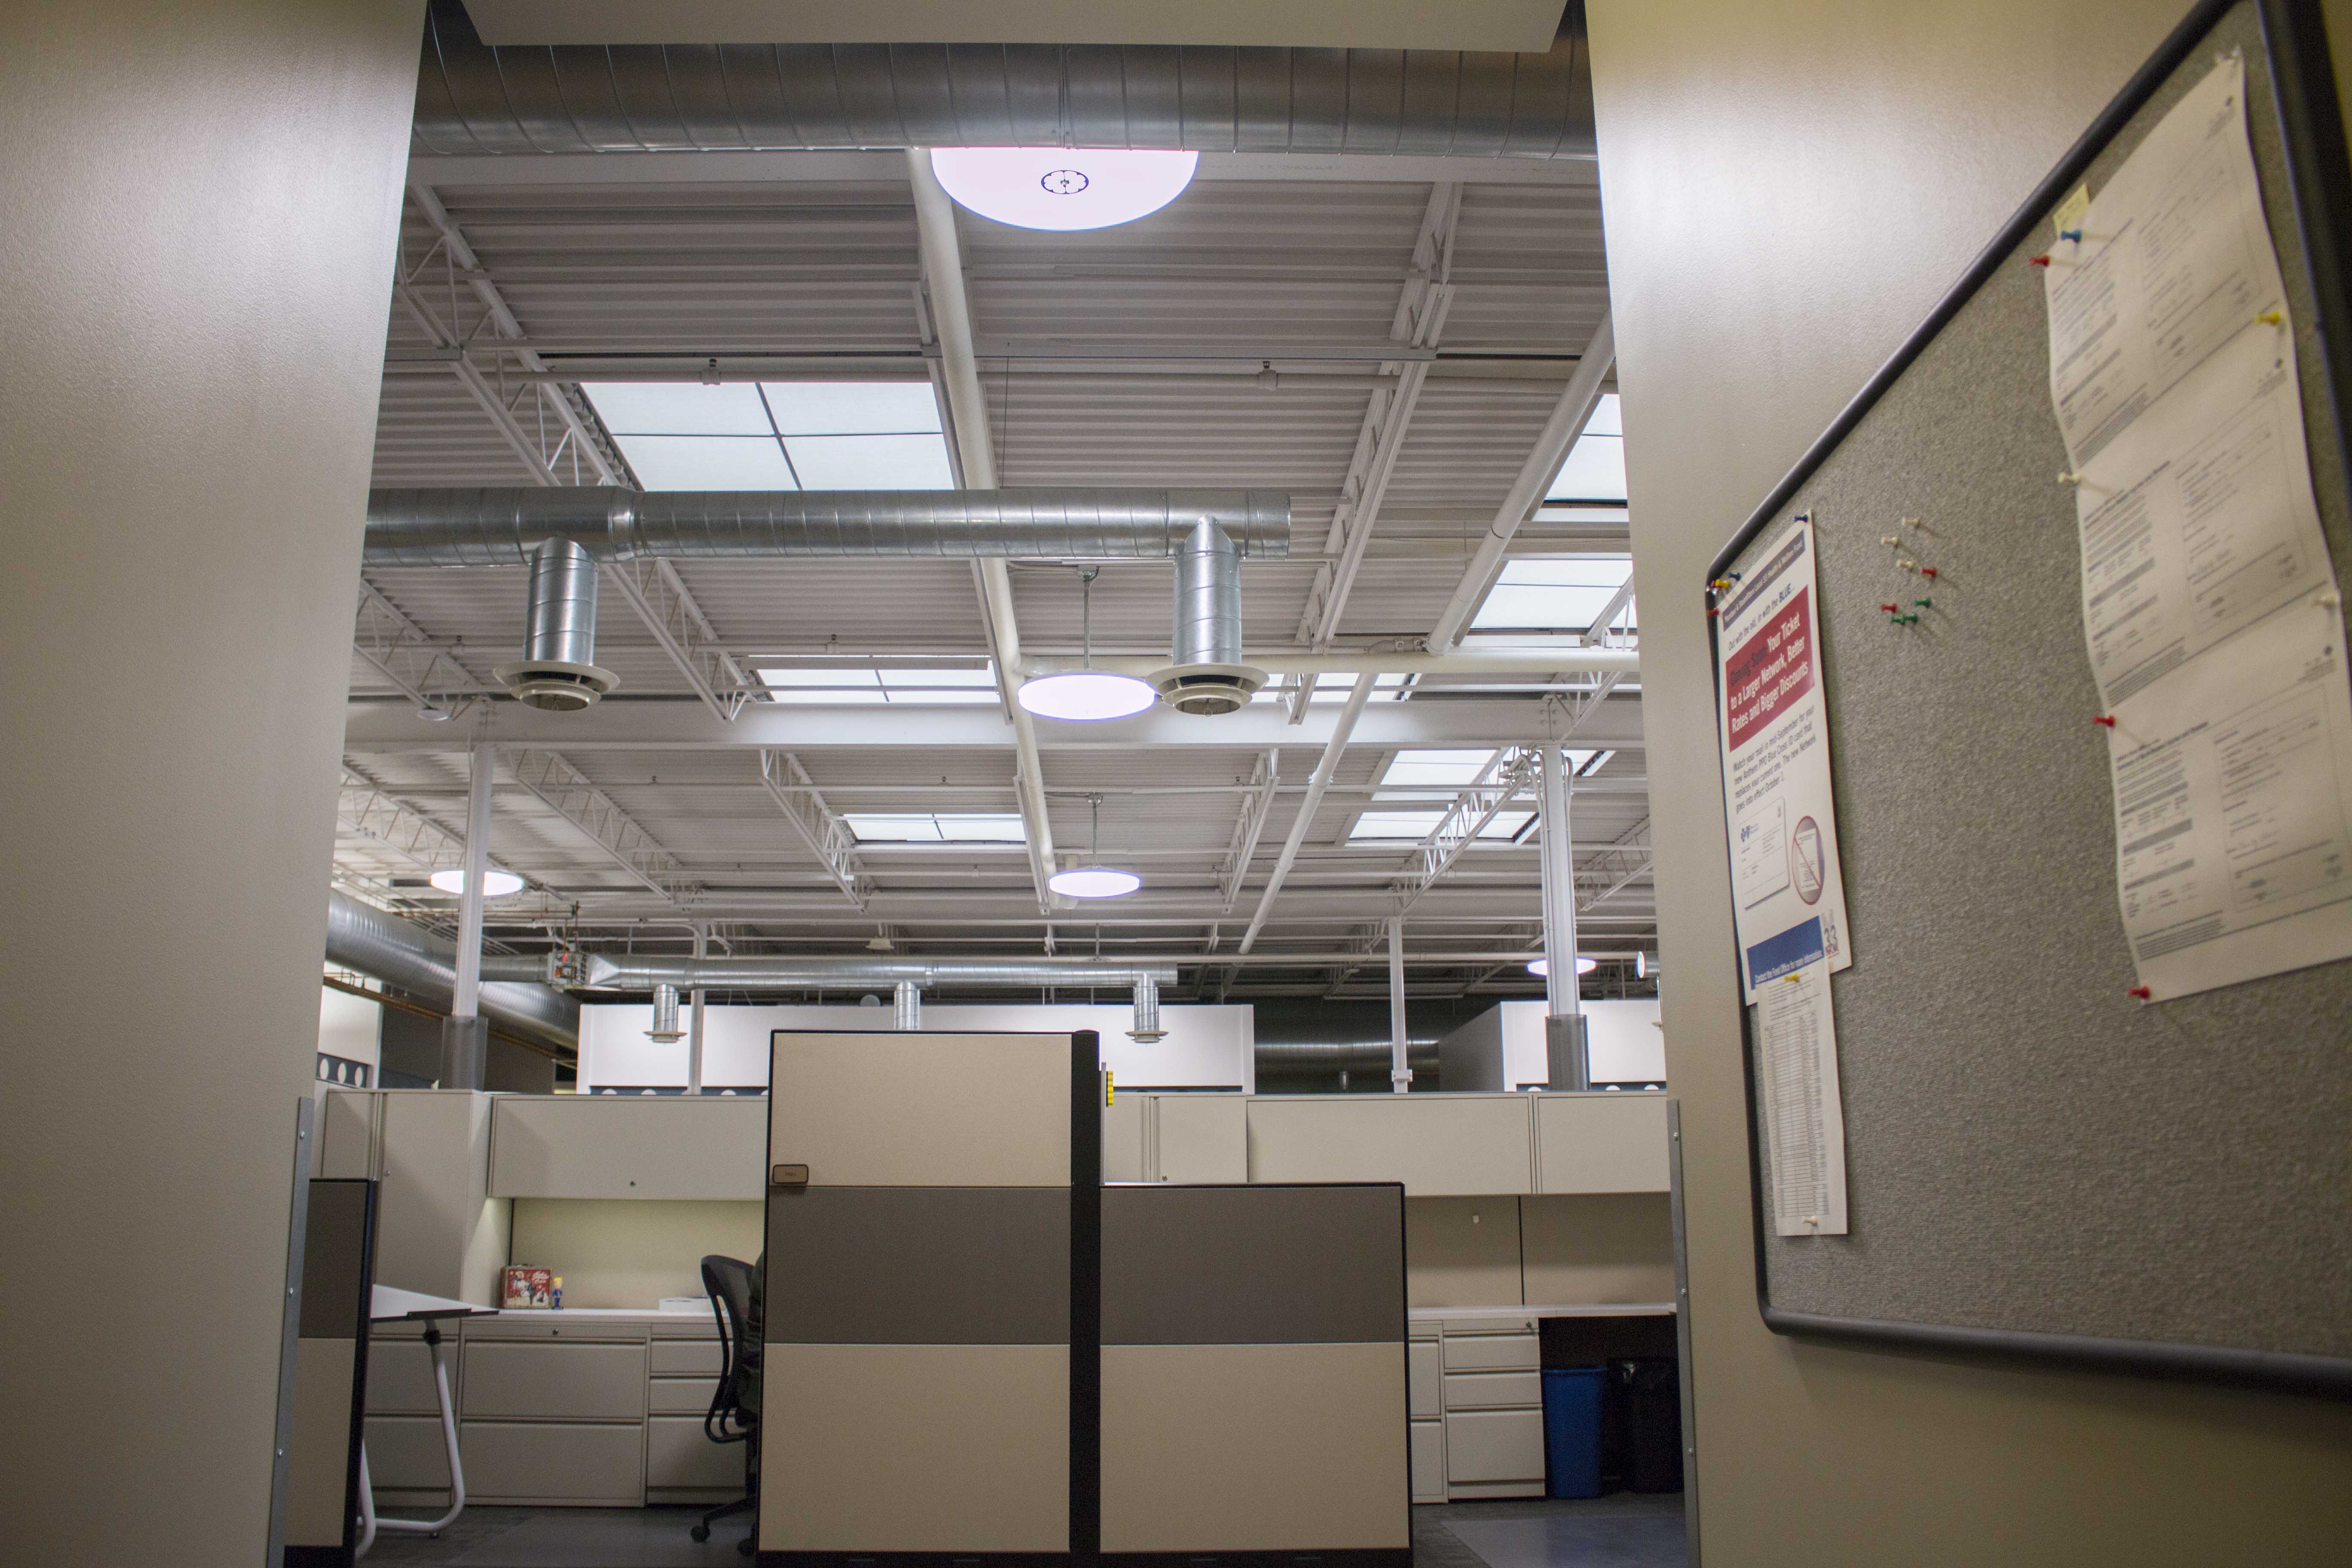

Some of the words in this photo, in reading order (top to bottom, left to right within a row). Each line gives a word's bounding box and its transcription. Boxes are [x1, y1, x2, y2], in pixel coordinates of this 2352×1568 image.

[1767, 631, 1781, 653] Your
[1781, 612, 1801, 640] Ticket
[1730, 696, 1737, 710] to
[1738, 692, 1742, 705] a
[1742, 676, 1761, 701] Larger
[1761, 653, 1787, 686] Network,
[1787, 636, 1804, 662] Better
[1732, 713, 1749, 734] Rates
[1749, 699, 1760, 721] and
[1761, 686, 1779, 712] Bigger
[1779, 661, 1808, 696] Discounts
[1733, 757, 1746, 772] Watch
[1746, 752, 1755, 766] your
[1755, 744, 1764, 756] mail
[1764, 741, 1769, 750] in
[1806, 705, 1815, 720] your
[1734, 775, 1742, 785] new
[1744, 764, 1758, 779] Anthem
[1759, 755, 1767, 767] PPO
[1768, 750, 1776, 762] Blue
[1777, 742, 1788, 755] Cross
[1788, 735, 1793, 746] ID
[1794, 728, 1803, 742] card
[1804, 721, 1812, 734] that
[1735, 783, 1751, 798] replaces
[1760, 765, 1773, 782] current
[1800, 733, 1816, 752] Network
[1736, 801, 1746, 814] goes
[1754, 787, 1764, 800] effect
[1765, 777, 1780, 792] October
